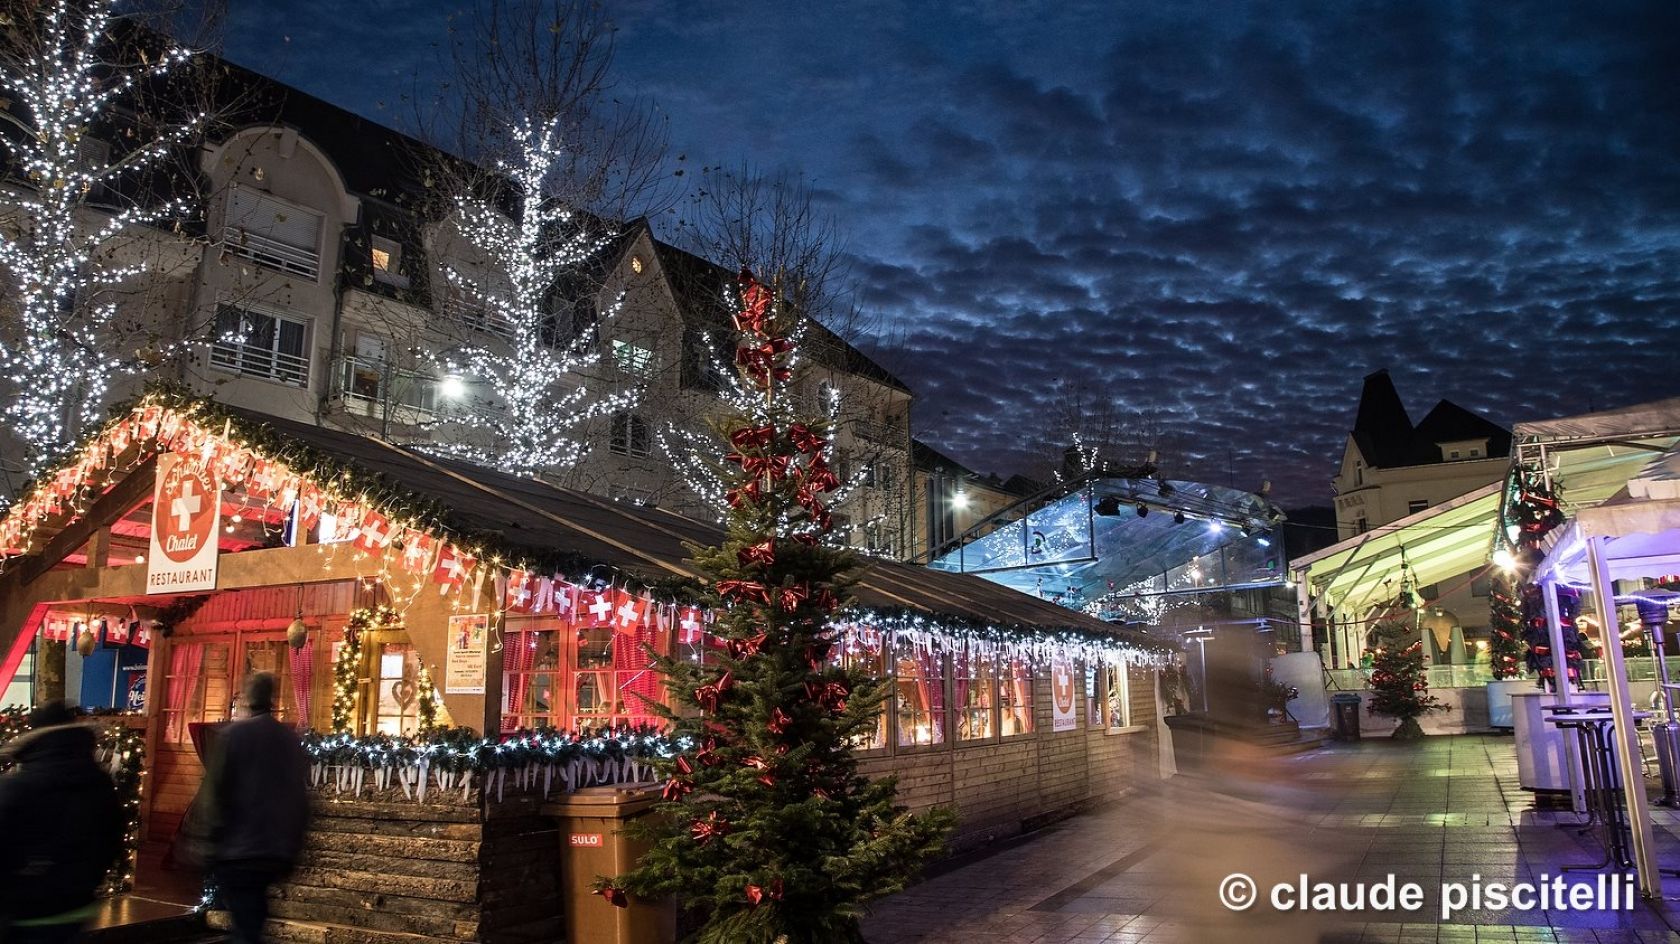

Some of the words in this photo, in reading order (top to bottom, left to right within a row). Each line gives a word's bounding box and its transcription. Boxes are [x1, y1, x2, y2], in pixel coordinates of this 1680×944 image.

[166, 534, 198, 552] Chalet
[150, 569, 213, 586] RESTAURANT
[571, 835, 598, 845] SULO
